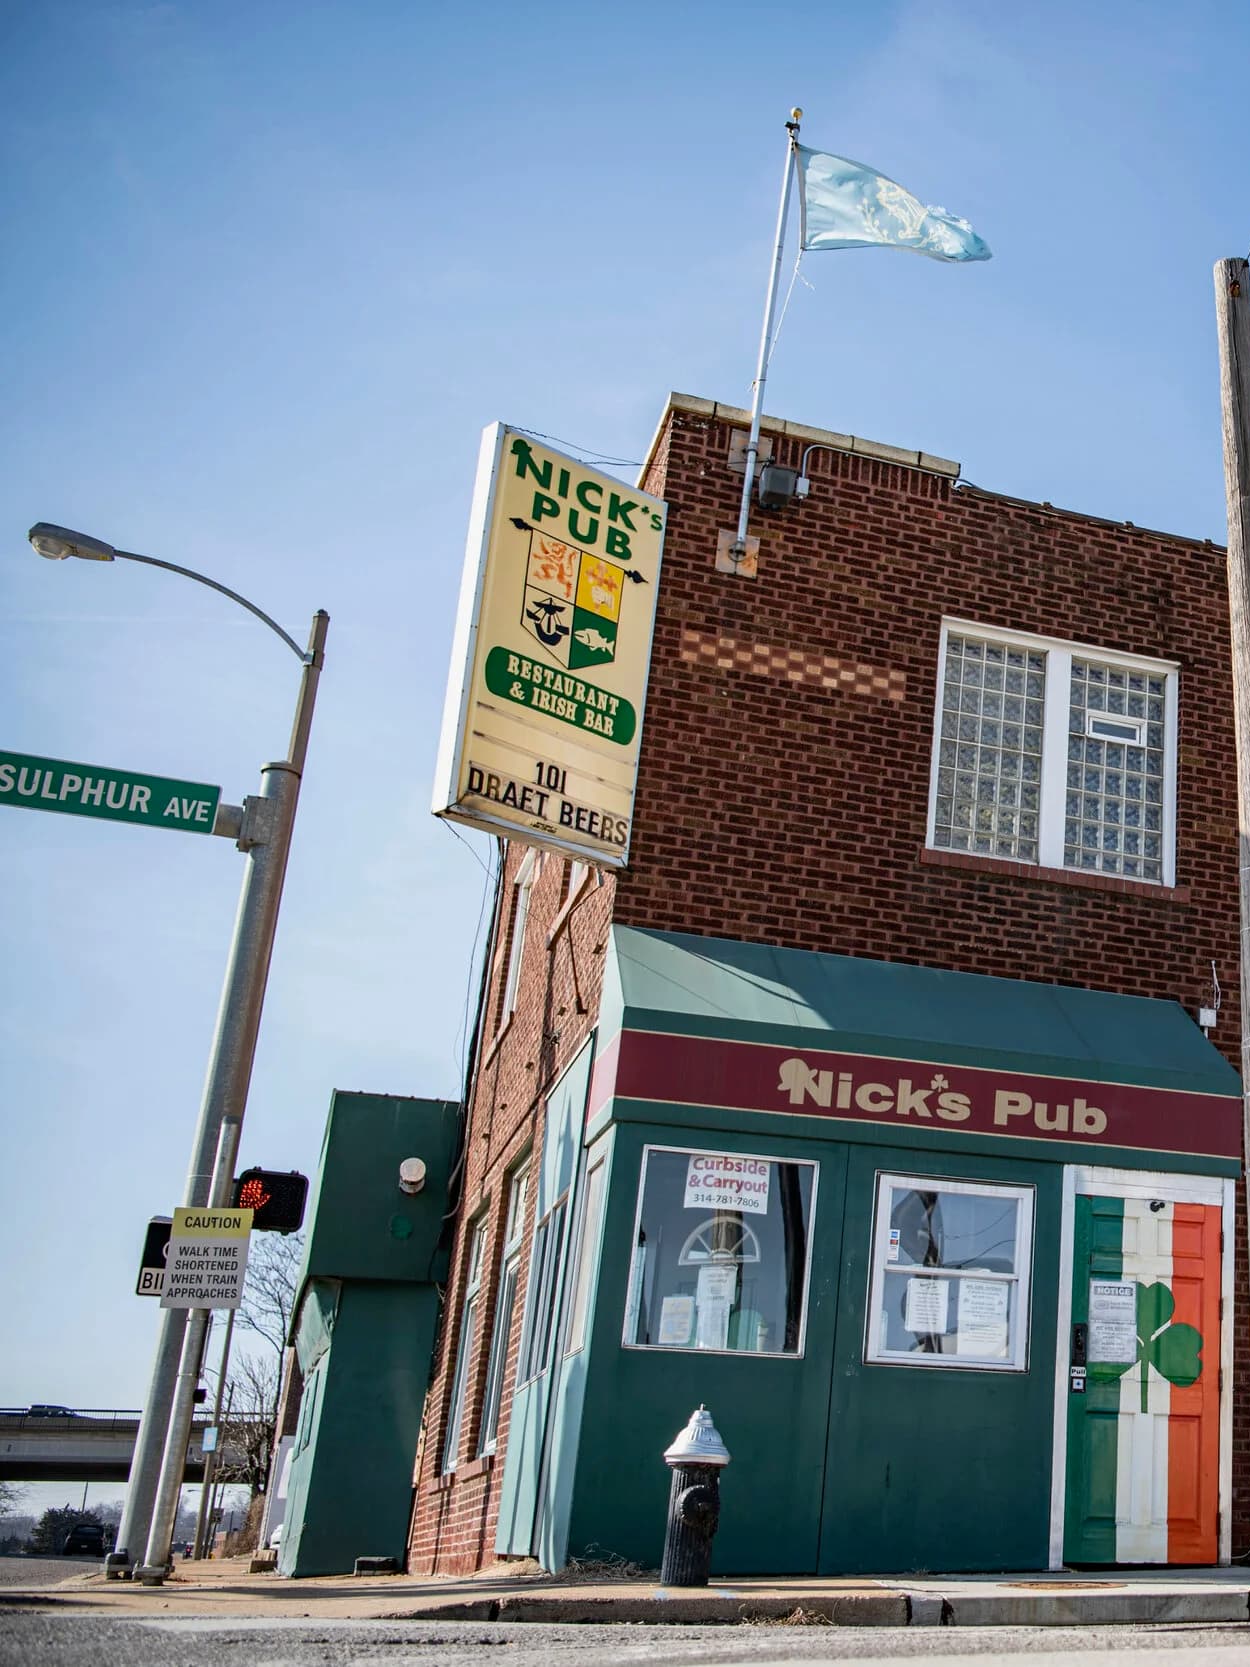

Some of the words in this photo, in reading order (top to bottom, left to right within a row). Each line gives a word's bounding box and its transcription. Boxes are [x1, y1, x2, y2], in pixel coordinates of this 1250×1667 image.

[532, 491, 632, 560] PUB
[507, 654, 620, 716] RESTAURANT
[510, 681, 525, 700] &
[532, 687, 579, 722] IRISH
[583, 708, 614, 736] BAR
[0, 764, 152, 813] SULPHUR
[163, 797, 212, 822] AVE
[468, 767, 550, 820] DRAFT
[559, 801, 628, 846] BEERS
[778, 1058, 972, 1121] Nick's
[993, 1089, 1107, 1135] Pub
[693, 1157, 768, 1176] Curbside
[703, 1174, 767, 1194] Carryout
[693, 1194, 760, 1208] 314-781-7806
[184, 1216, 242, 1229] CAUTION
[179, 1246, 210, 1257] WALK
[213, 1246, 239, 1257] TIME
[174, 1260, 239, 1271] SHORTENED
[171, 1273, 203, 1284] WHEN
[206, 1274, 238, 1285] TRAIN
[166, 1287, 238, 1299] APPROACHES
[1096, 1286, 1132, 1296] NOTICE
